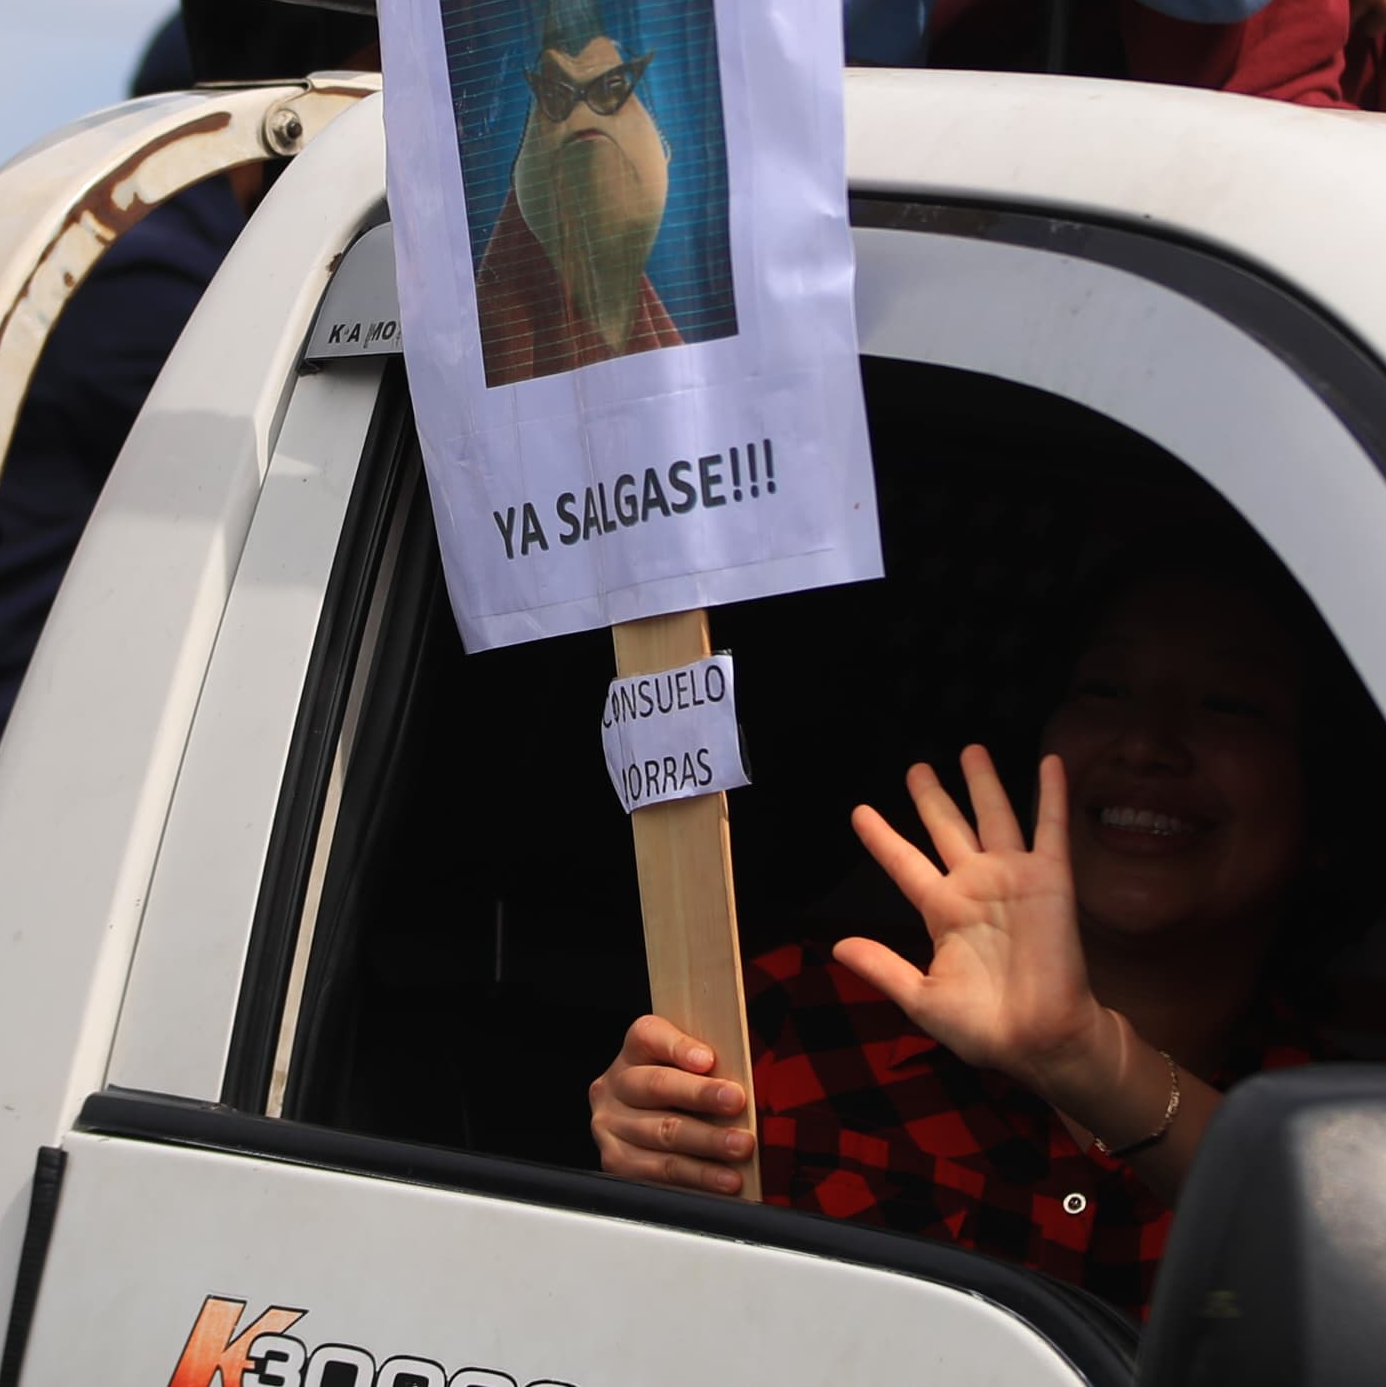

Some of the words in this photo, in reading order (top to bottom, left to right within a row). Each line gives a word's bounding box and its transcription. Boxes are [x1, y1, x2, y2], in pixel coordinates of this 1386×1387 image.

[493, 501, 549, 559] YA
[556, 438, 777, 545] SALGASE!!!
[621, 748, 714, 804] ORRAS
[166, 1294, 585, 1387] K30
